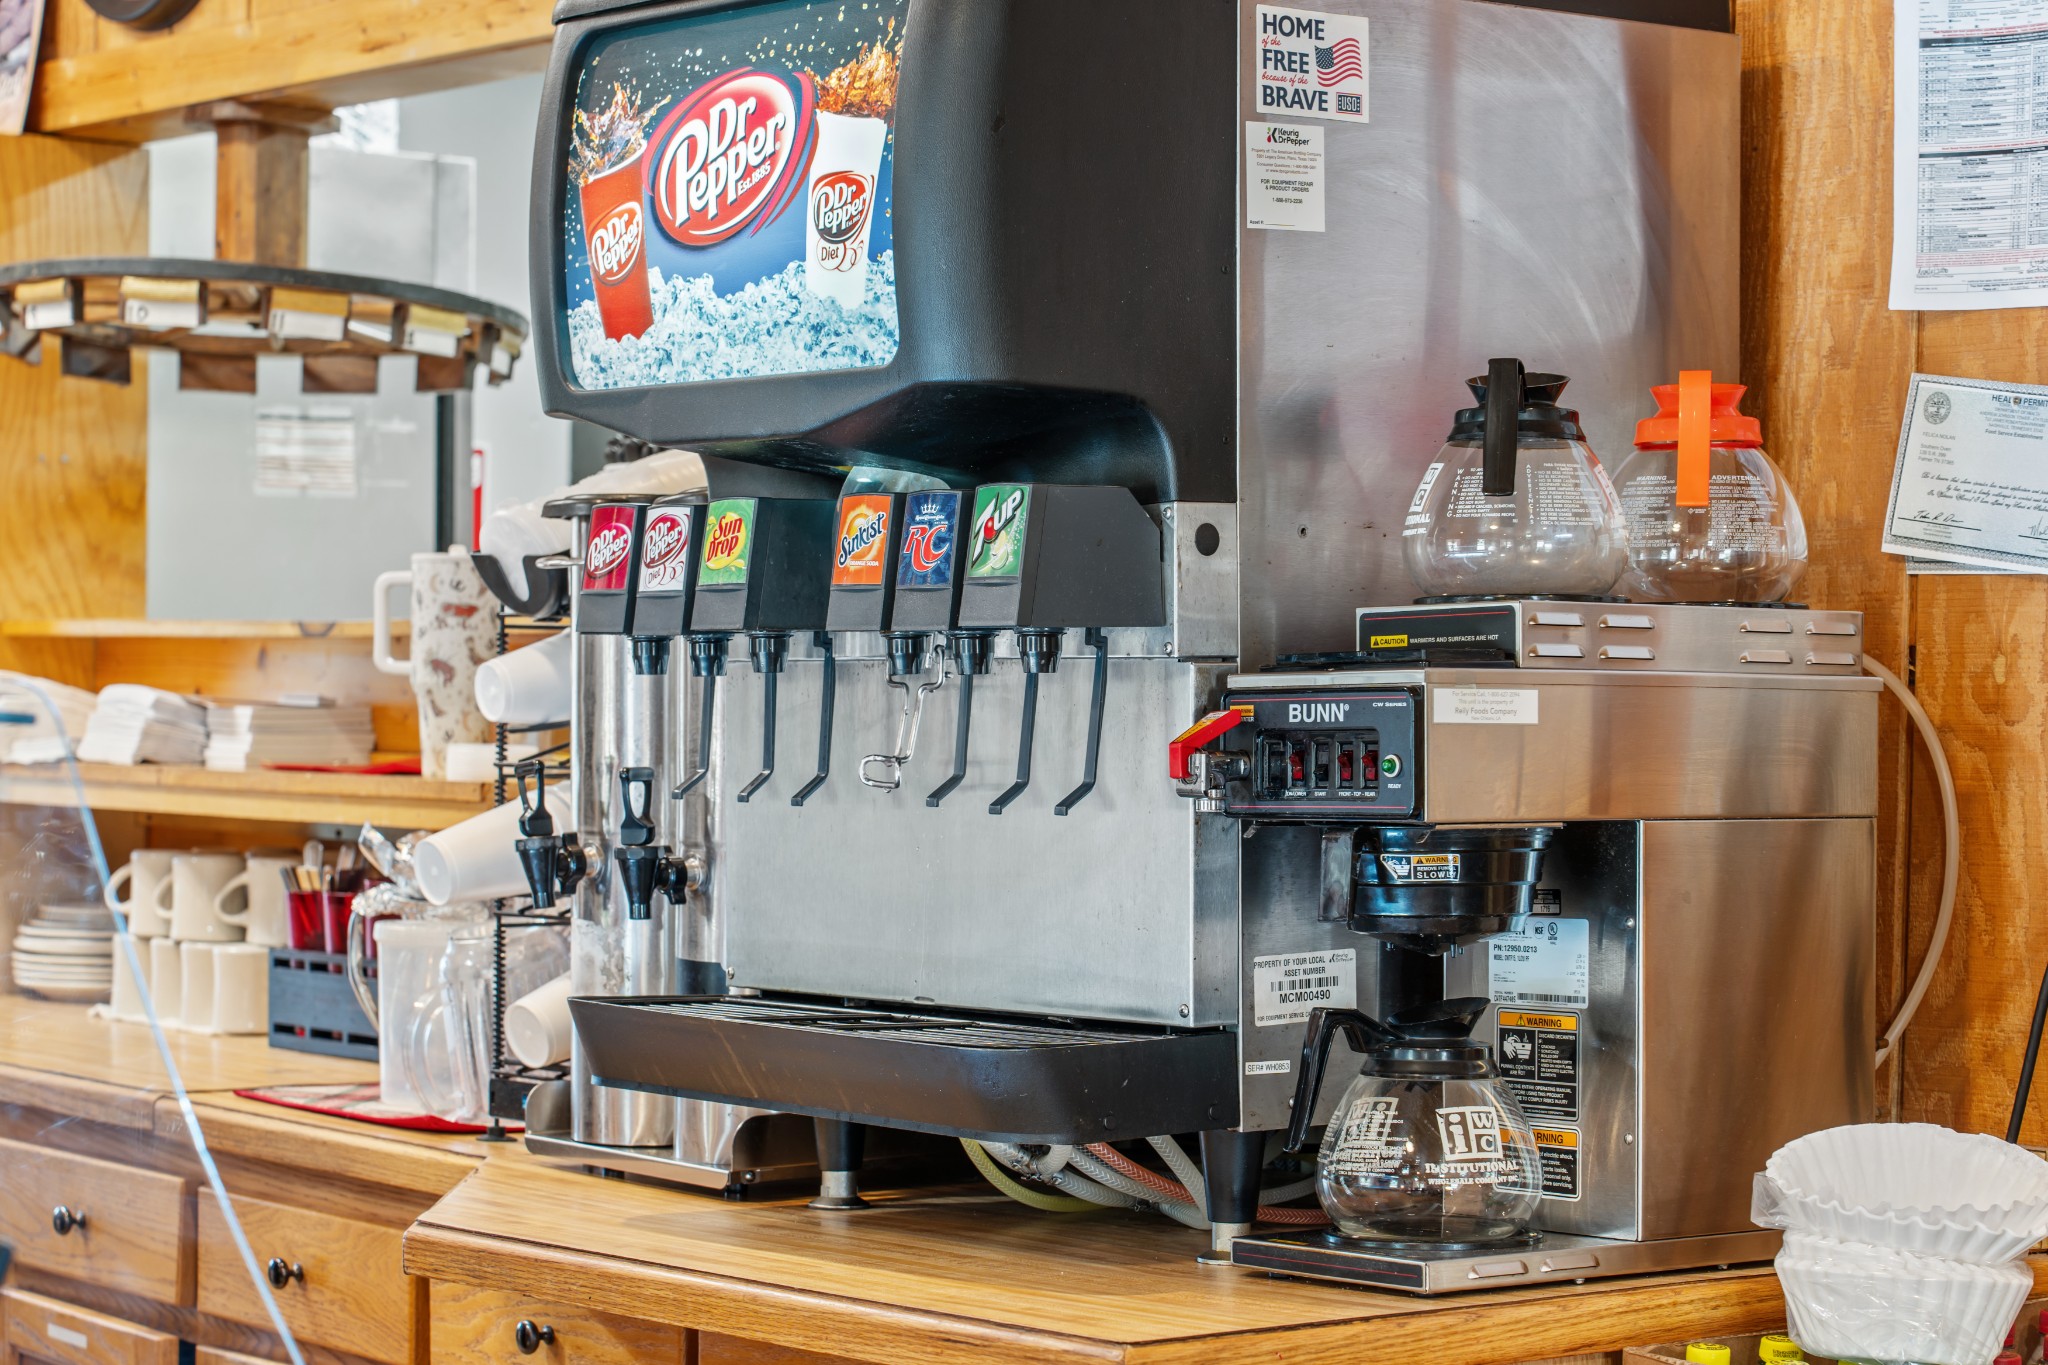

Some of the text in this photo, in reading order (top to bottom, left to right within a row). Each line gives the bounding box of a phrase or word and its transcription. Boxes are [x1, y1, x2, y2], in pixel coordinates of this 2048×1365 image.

[1262, 13, 1325, 41] HOME
[1262, 35, 1281, 48] of the
[1262, 48, 1309, 74] FREE
[1262, 71, 1308, 87] because of the
[1262, 85, 1328, 112] BRAVE
[1341, 97, 1357, 111] USO
[709, 96, 757, 164] Dr
[1278, 127, 1299, 138] Keurig
[661, 112, 786, 228] Pepper
[834, 182, 857, 209] Dr
[815, 186, 867, 234] Pepper
[607, 213, 629, 247] Dr
[592, 213, 639, 275] Pepper
[821, 246, 839, 261] Diet
[656, 521, 670, 543] Dr
[713, 515, 743, 540] Sun
[601, 528, 617, 550] Dr
[643, 526, 681, 562] Pepper
[706, 535, 739, 562] Drop
[838, 511, 886, 568] Sunkist
[904, 524, 949, 573] RC
[588, 533, 627, 571] Pepper
[648, 567, 661, 584] Diet
[1380, 637, 1405, 646] CAUTION
[1455, 707, 1469, 715] Reily
[1490, 708, 1517, 716] Company
[1535, 926, 1544, 934] NSF
[1254, 956, 1326, 969] PROPERTY OF YOUR LOCAL
[1284, 966, 1326, 977] ASSET NUMBER
[1279, 989, 1331, 1004] MCM00490
[1526, 1017, 1562, 1028] WARNING
[1247, 1063, 1264, 1073] SER#
[1425, 1160, 1520, 1174] INSTITUTIONAL
[1474, 1176, 1507, 1184] COMPANY
